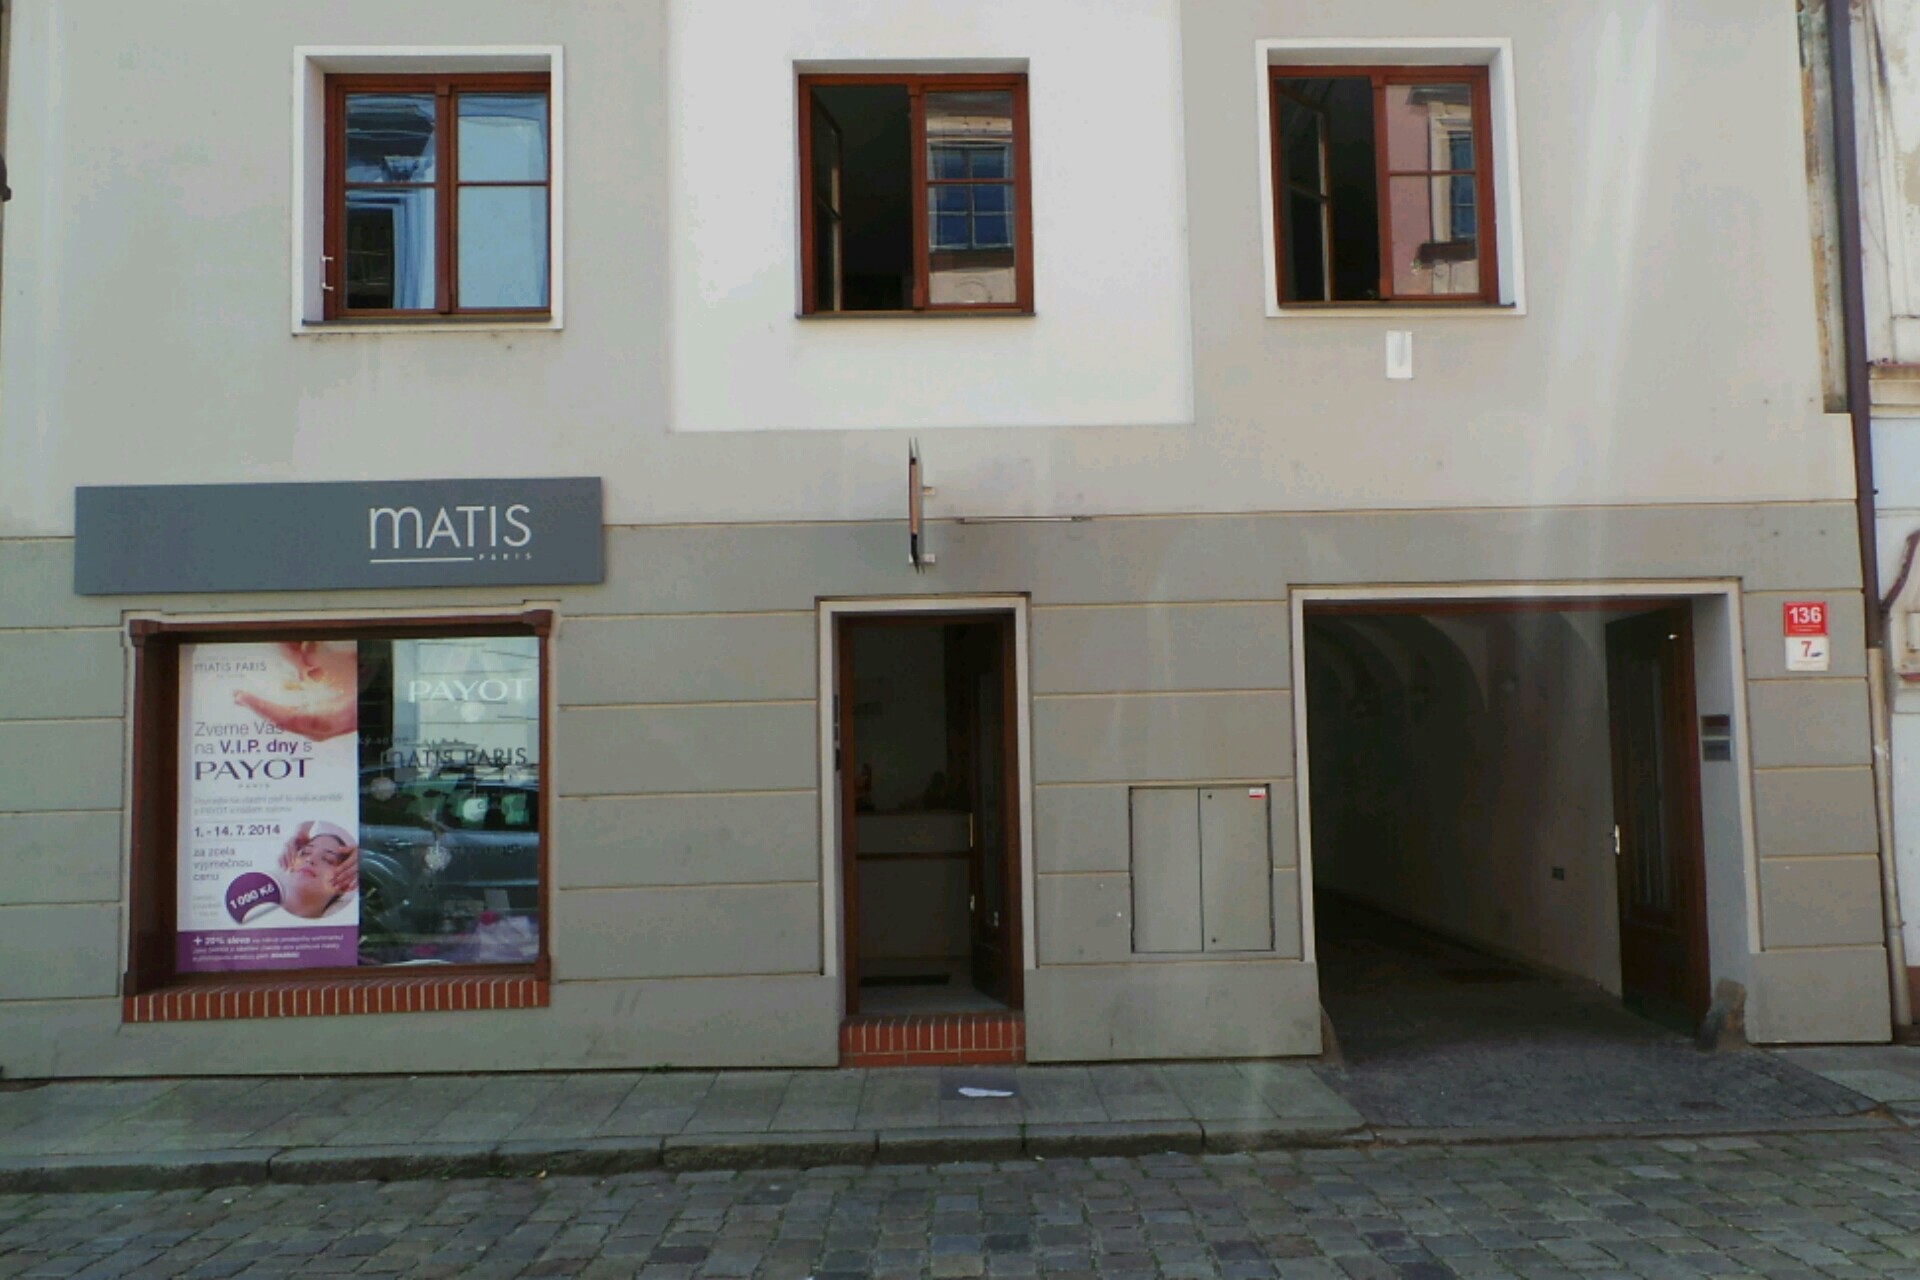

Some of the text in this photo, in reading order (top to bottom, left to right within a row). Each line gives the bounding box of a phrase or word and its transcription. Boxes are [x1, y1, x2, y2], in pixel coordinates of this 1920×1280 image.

[479, 553, 532, 561] PARIS
[1789, 606, 1822, 624] 136
[1801, 640, 1811, 657] 7
[235, 661, 267, 671] PARIS
[408, 678, 533, 703] PAYOT
[194, 721, 249, 737] Zveme
[194, 738, 313, 755] na V.I.P. dny s
[465, 746, 527, 768] PARIS
[194, 757, 314, 780] PAYOT
[249, 824, 281, 836] 2014
